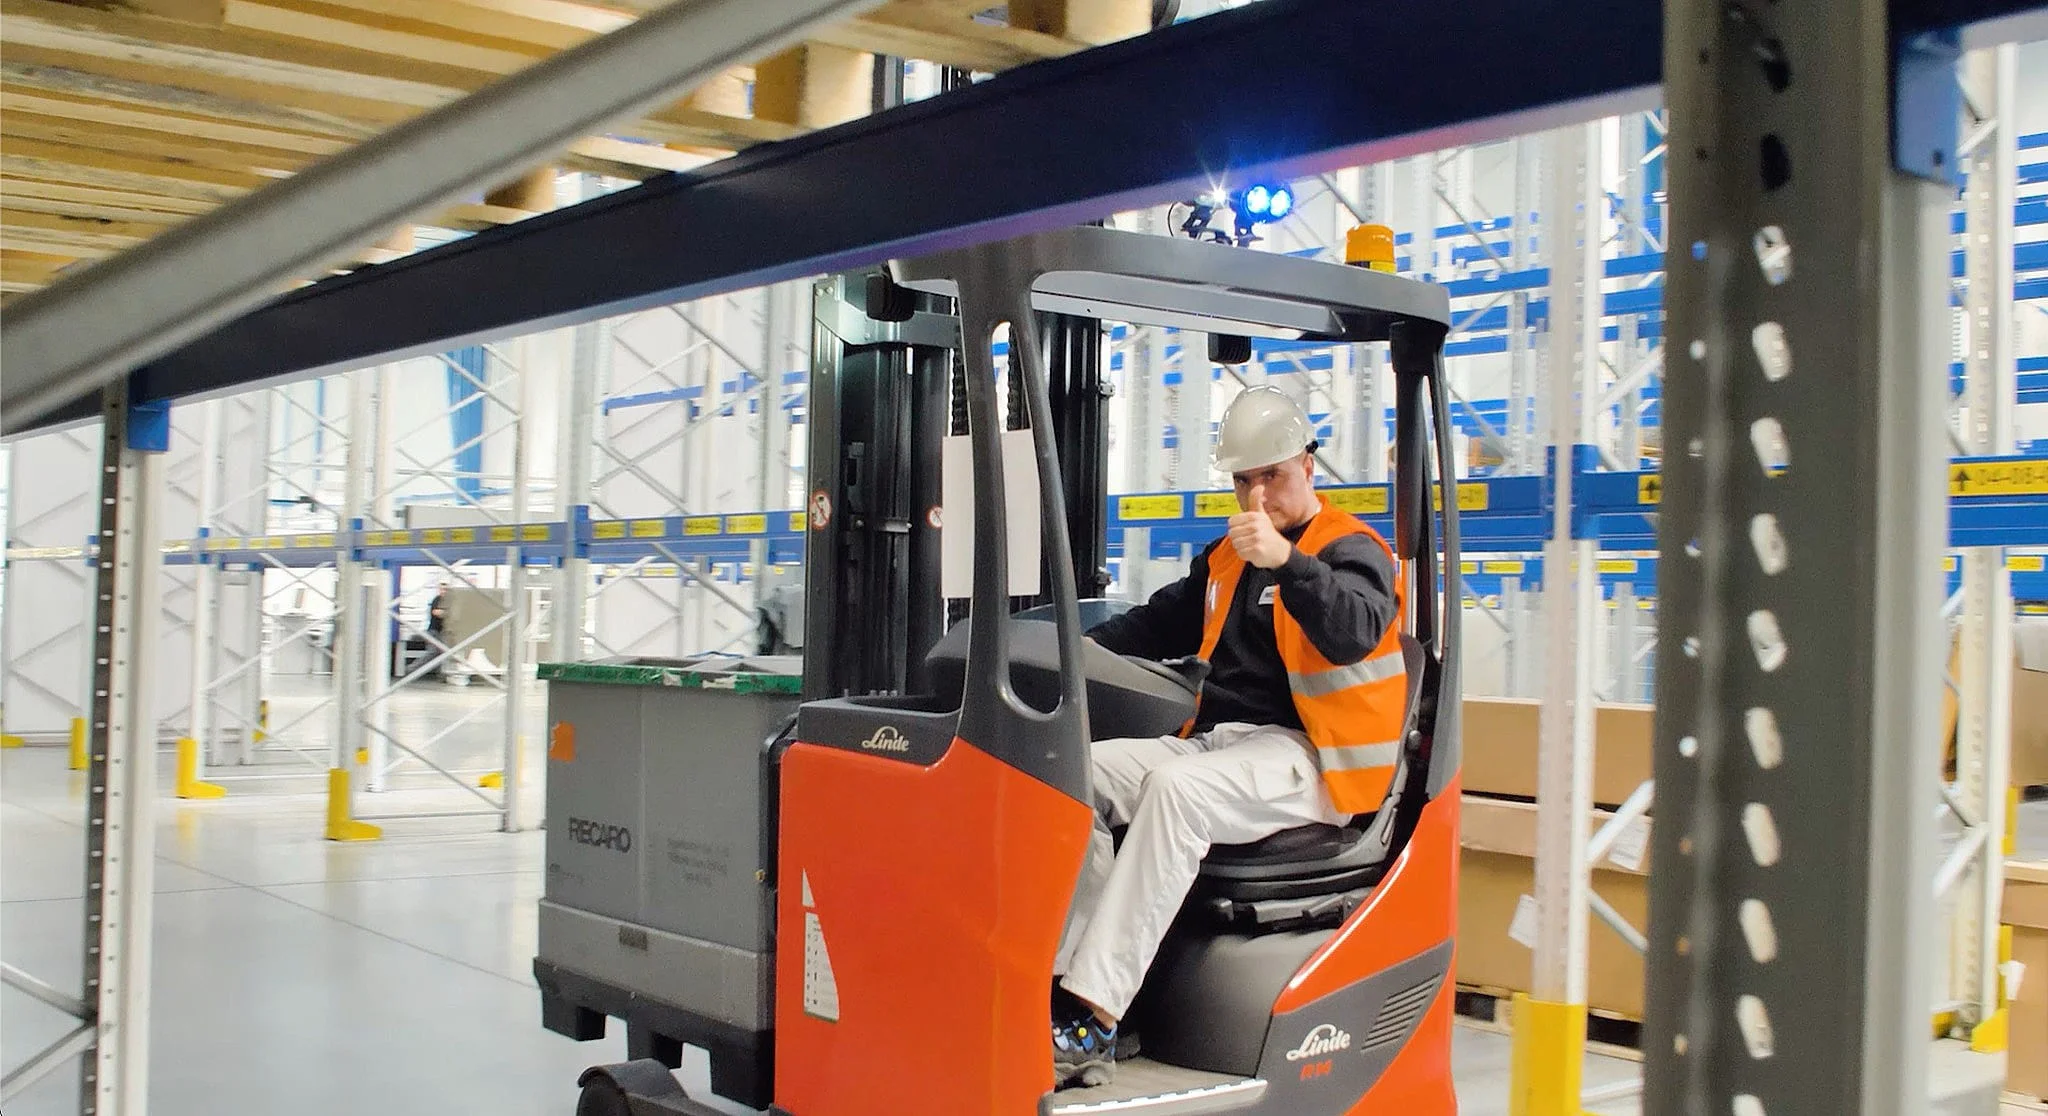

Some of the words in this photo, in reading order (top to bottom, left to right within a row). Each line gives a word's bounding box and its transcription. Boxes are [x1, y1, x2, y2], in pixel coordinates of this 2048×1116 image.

[861, 725, 910, 752] Linde
[568, 816, 631, 854] RECARO
[1286, 1023, 1351, 1061] Linde
